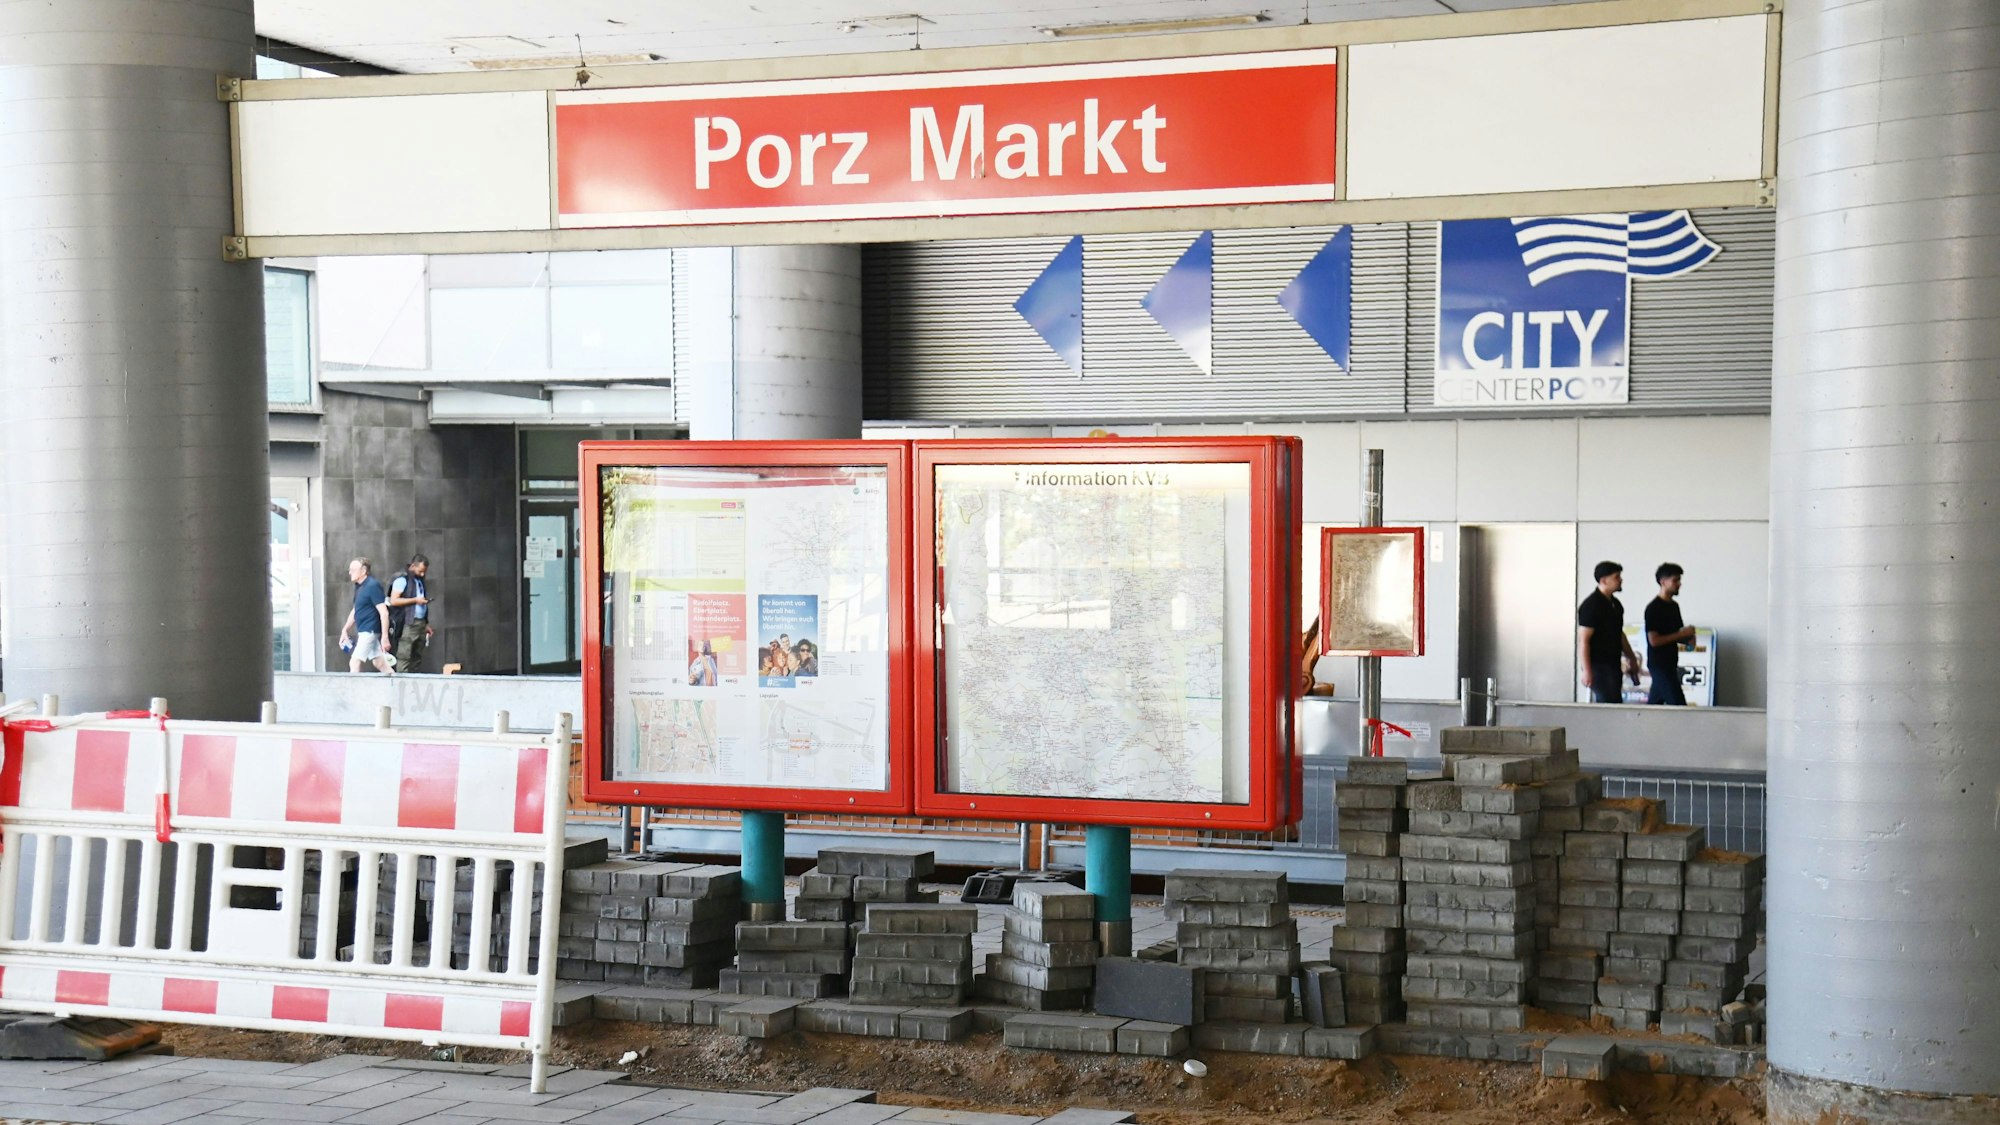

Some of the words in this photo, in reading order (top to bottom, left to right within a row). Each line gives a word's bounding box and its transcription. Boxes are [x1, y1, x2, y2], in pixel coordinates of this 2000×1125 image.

[694, 116, 869, 190] Porz
[909, 98, 1167, 182] Markt
[1462, 309, 1609, 369] CITY
